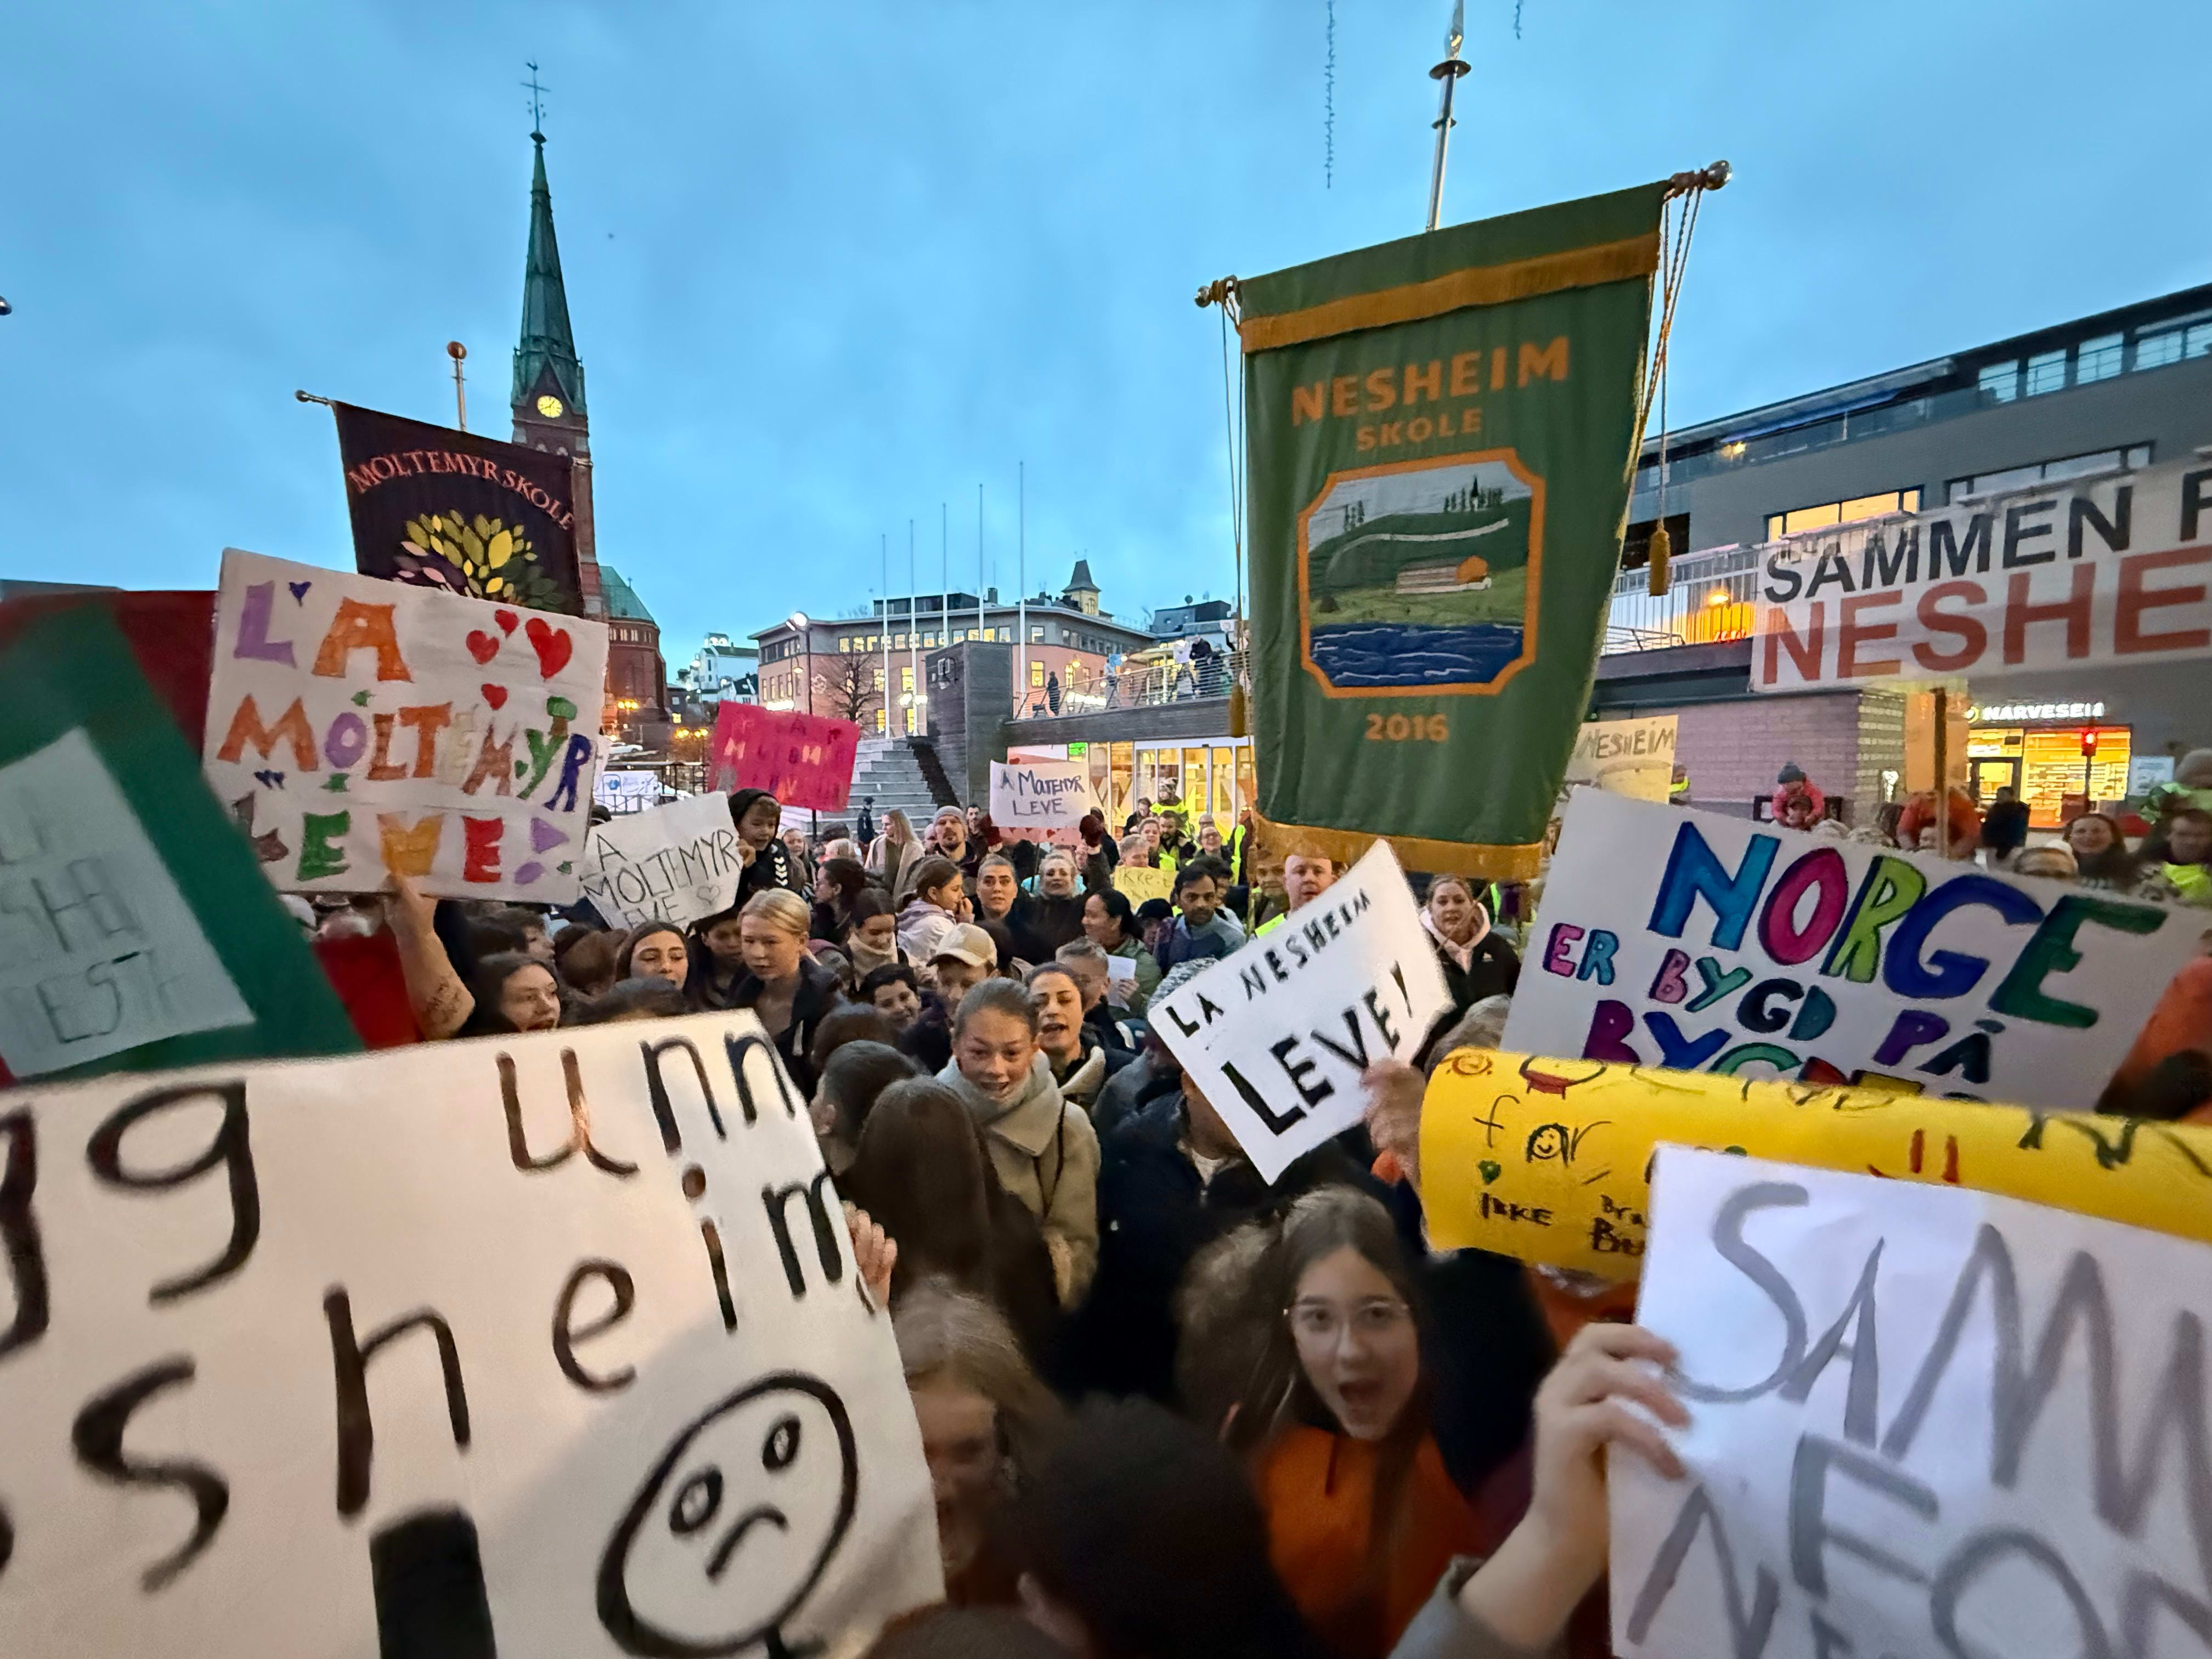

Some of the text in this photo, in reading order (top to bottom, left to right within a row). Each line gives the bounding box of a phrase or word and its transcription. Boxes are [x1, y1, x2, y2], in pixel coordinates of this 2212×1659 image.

[1291, 335, 1570, 427] NESHEIM
[1356, 408, 1482, 452] SKOLE
[348, 448, 575, 531] MOLTEMYR SKOLE
[1764, 485, 2134, 603] SAMMEN
[1762, 544, 2212, 685] NESHE
[1365, 713, 1449, 742] 2016
[1574, 720, 1676, 760] NESHEIM
[1012, 797, 1068, 816] LEVE
[1165, 888, 1373, 1039] LA NESHEIM
[1646, 821, 2169, 1028] NORGE
[1221, 960, 1413, 1137] LEVE!
[1542, 922, 1620, 986] ER
[1649, 948, 1837, 1041] BYGD
[1872, 1009, 2007, 1084] PÅ
[495, 1029, 797, 1178] unn
[0, 1169, 876, 1594] sheim
